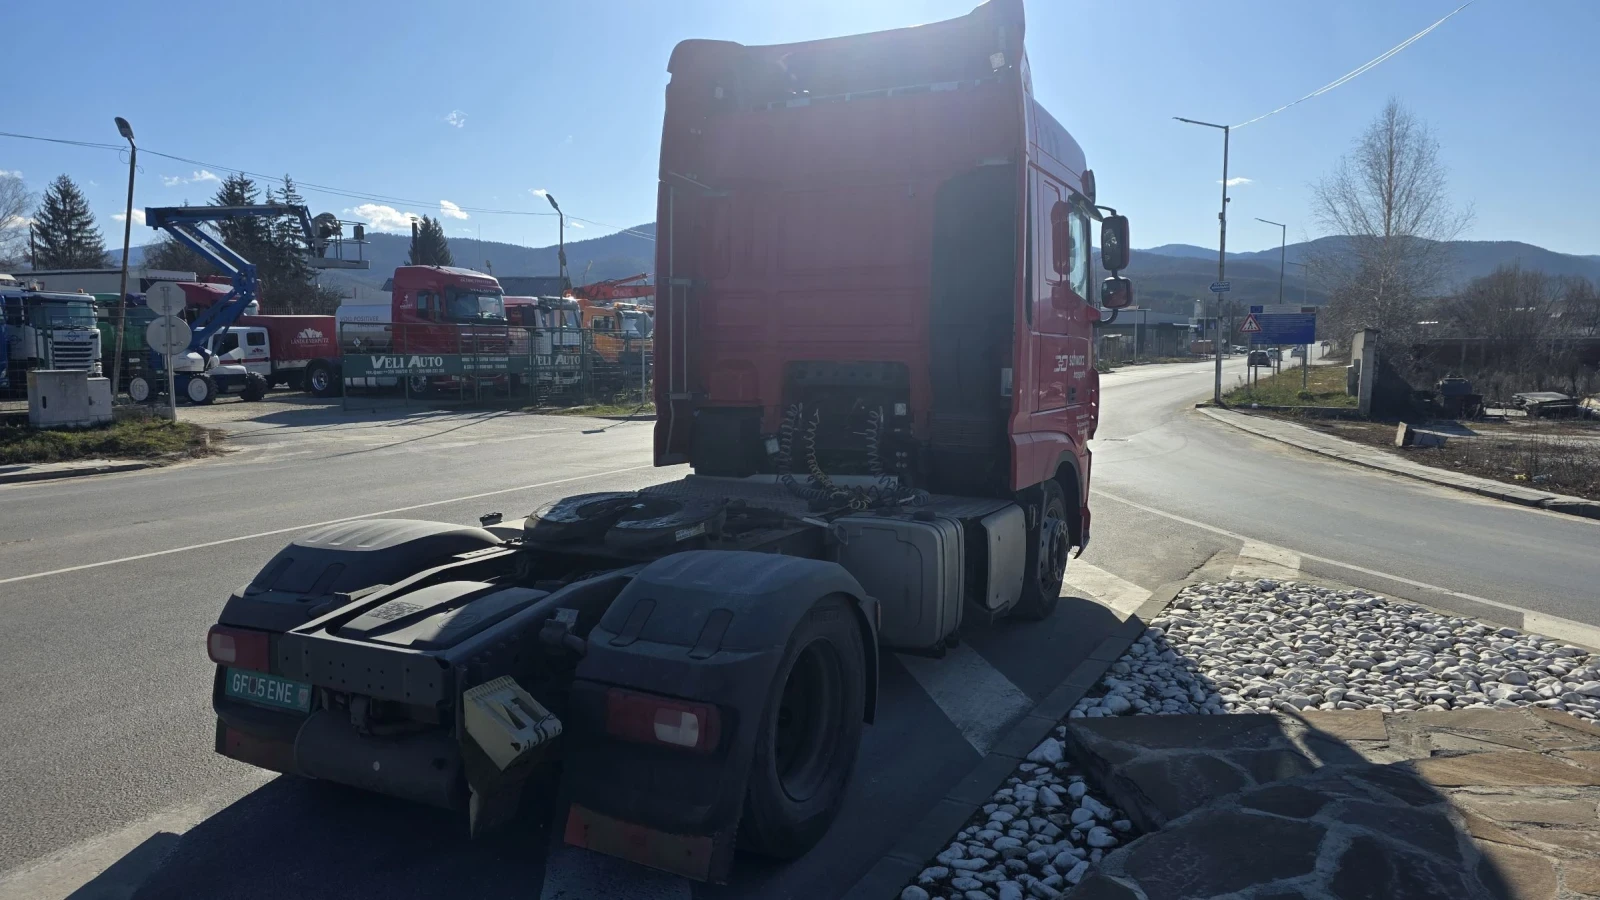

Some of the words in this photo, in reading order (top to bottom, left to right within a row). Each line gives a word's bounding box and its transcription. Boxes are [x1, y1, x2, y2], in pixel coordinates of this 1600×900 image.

[371, 355, 404, 369] VELI
[407, 355, 443, 368] AUTO
[554, 354, 581, 366] AUTO
